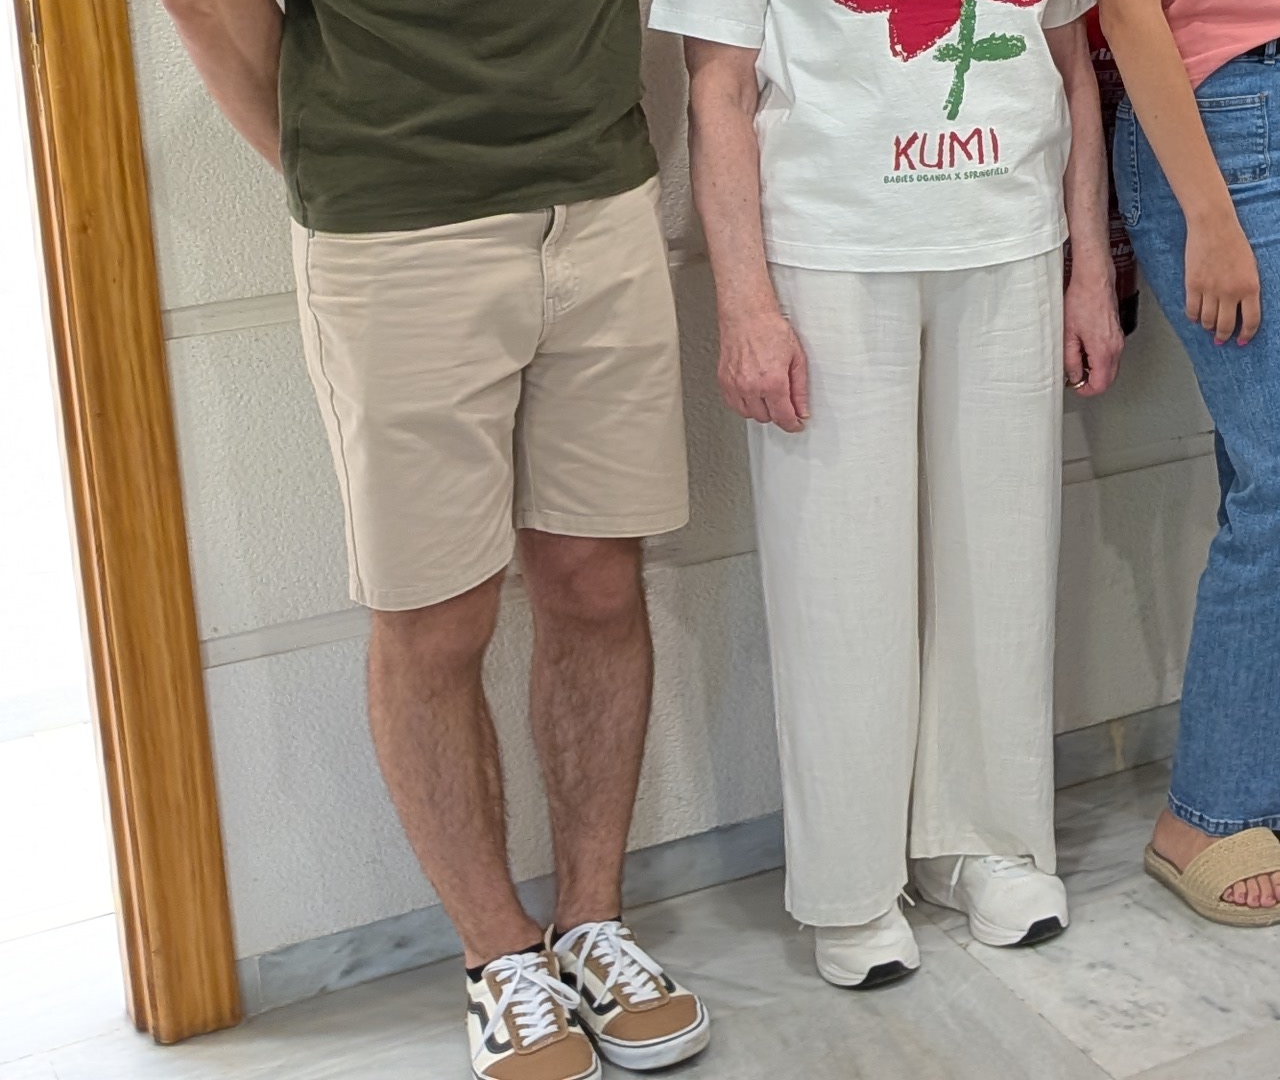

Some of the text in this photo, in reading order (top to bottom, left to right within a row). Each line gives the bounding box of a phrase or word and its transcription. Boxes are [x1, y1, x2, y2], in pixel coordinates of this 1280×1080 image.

[893, 127, 999, 171] KUMI
[884, 174, 914, 184] BABIES
[917, 174, 952, 182] UGANDA
[964, 167, 1009, 180] SPRINGFIELD
